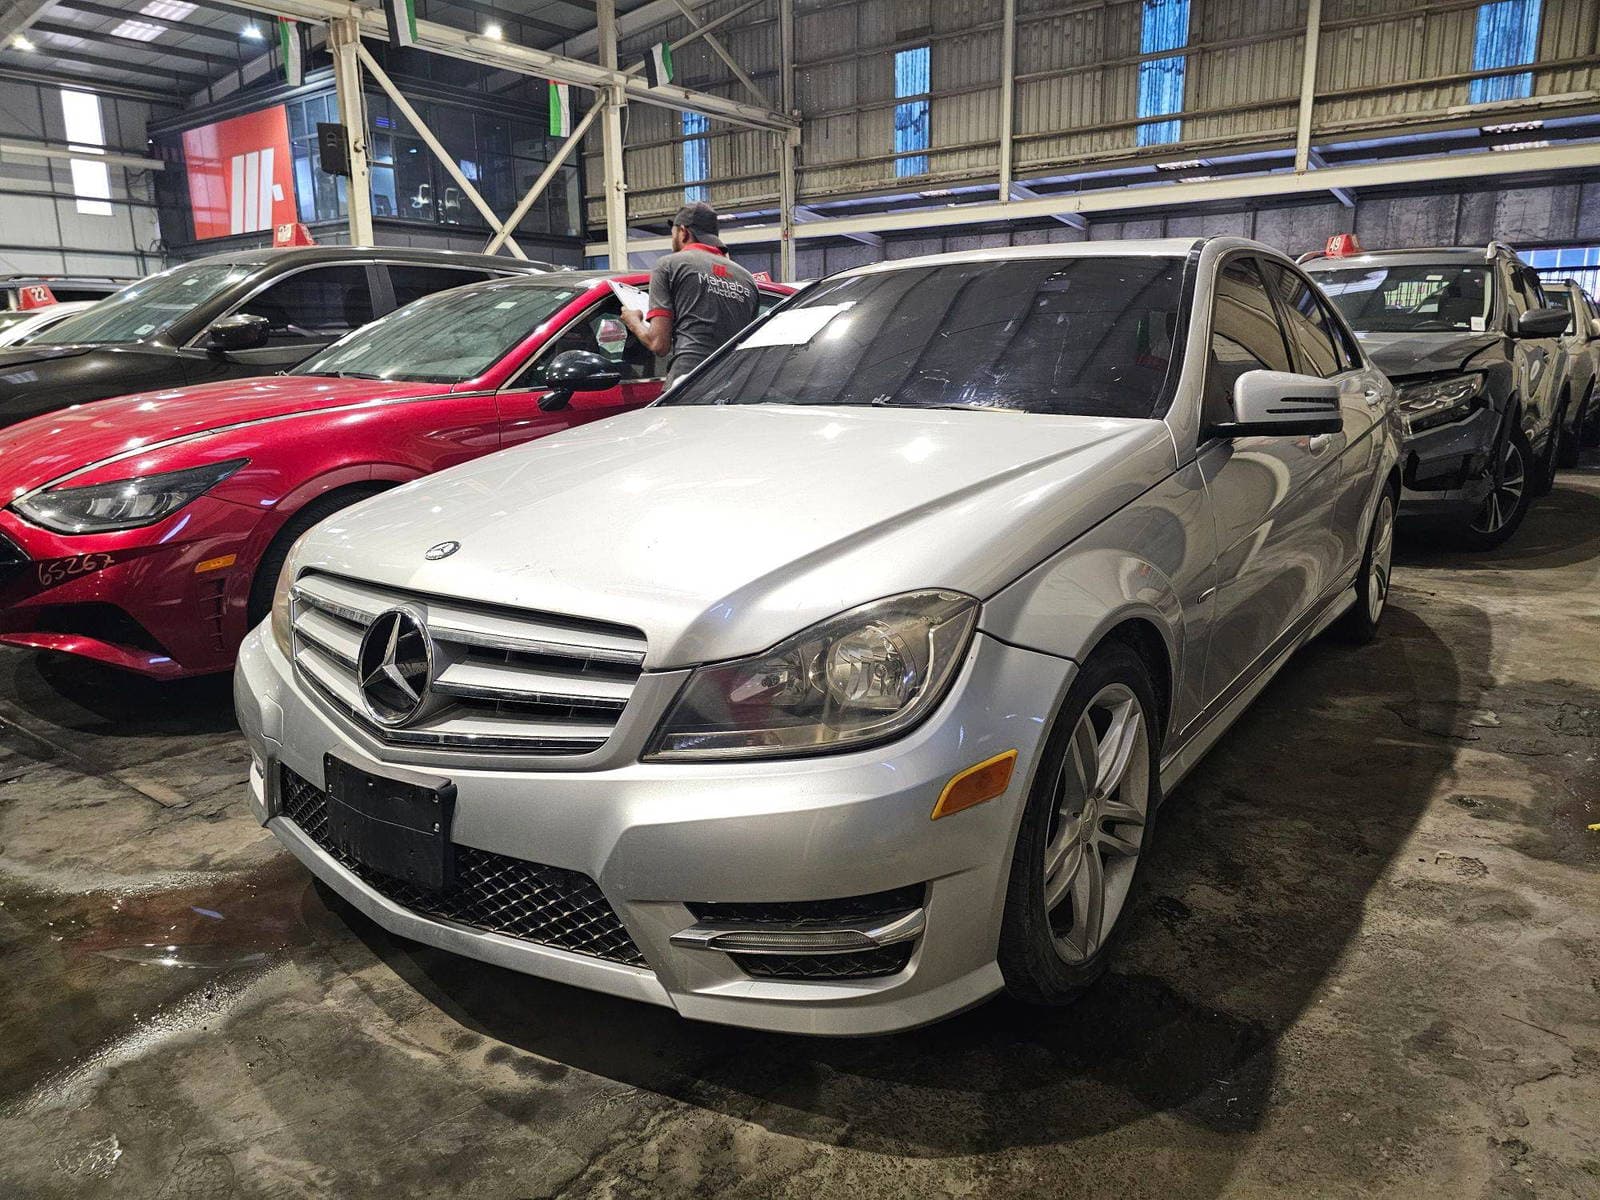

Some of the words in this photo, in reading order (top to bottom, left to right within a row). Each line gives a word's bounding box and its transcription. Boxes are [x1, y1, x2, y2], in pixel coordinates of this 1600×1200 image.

[31, 287, 48, 301] 22
[698, 272, 750, 297] Marhaba
[708, 285, 745, 302] Auctions
[39, 554, 115, 585] 65267
